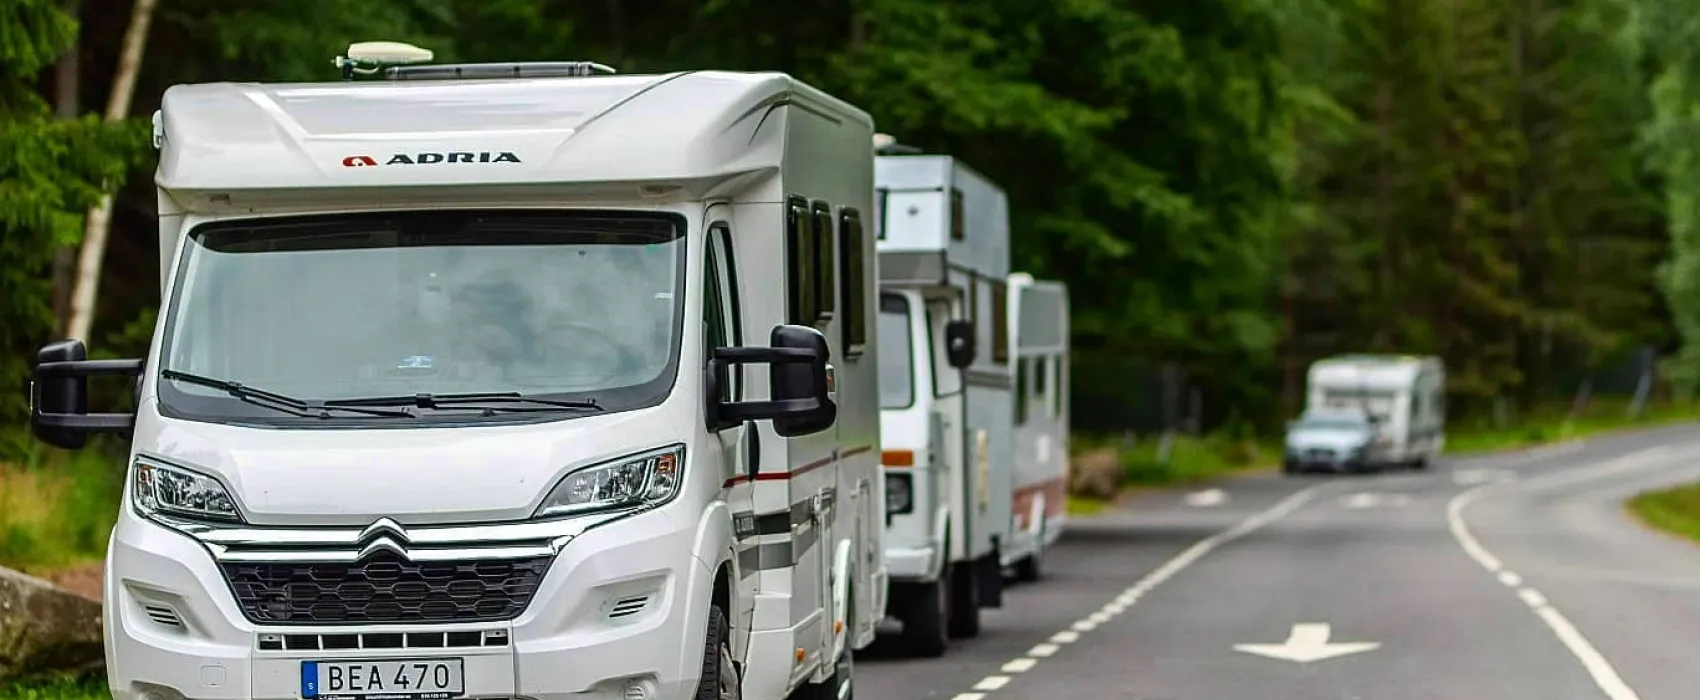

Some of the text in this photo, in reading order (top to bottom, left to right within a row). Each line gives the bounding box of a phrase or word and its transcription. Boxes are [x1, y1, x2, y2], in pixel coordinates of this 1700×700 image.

[386, 152, 522, 165] ADRIA
[328, 664, 449, 691] BEA 470
[308, 682, 314, 690] S
